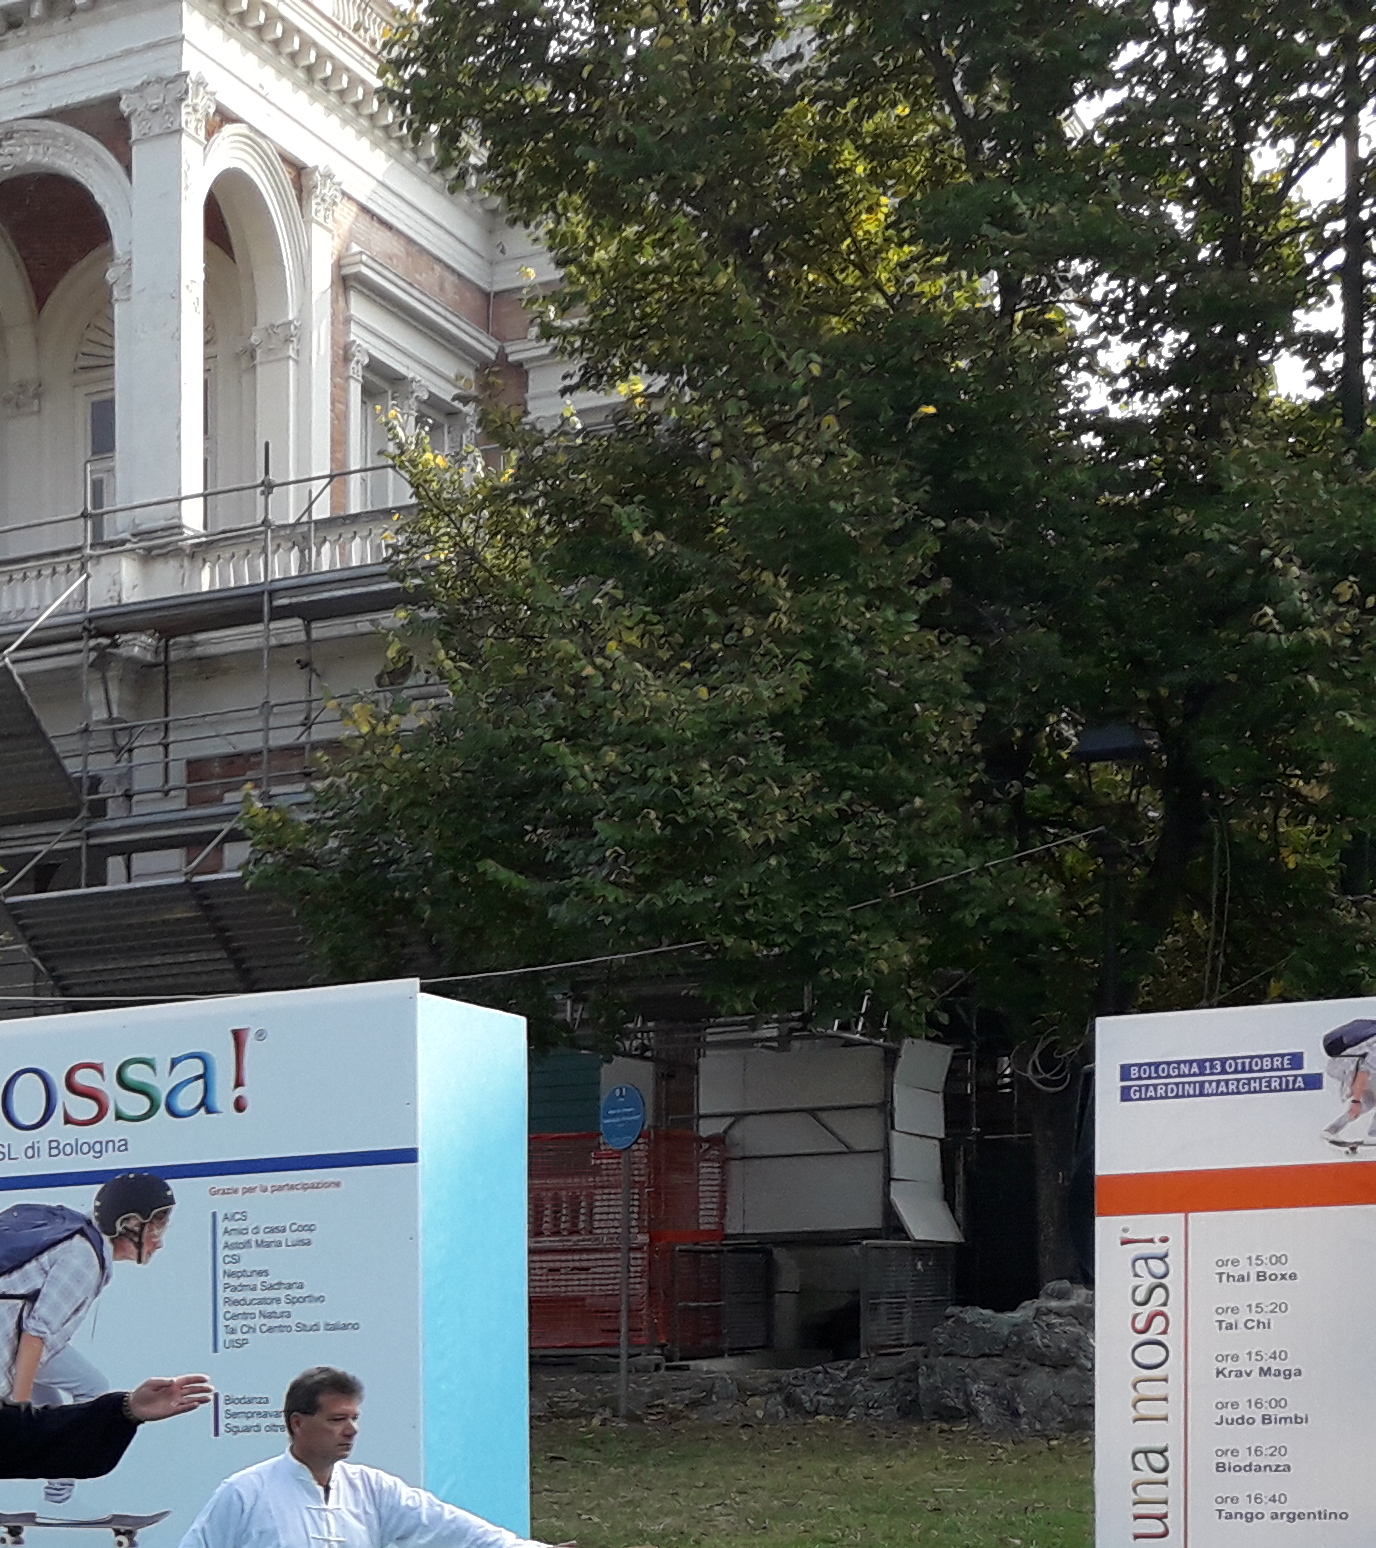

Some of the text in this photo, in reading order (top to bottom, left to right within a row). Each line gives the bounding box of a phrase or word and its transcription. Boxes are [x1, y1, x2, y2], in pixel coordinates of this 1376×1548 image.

[1130, 1055, 1293, 1080] BOLOGNA 13 OTTOBRE
[1130, 1076, 1305, 1099] GIARDINI MARGHERITA
[24, 1140, 41, 1160] di
[48, 1136, 129, 1160] Bologna
[209, 1180, 342, 1197] Grazie per la partecipazione
[222, 1211, 248, 1223] AICS
[263, 1224, 286, 1234] casa
[289, 1222, 317, 1234] Coop
[255, 1238, 283, 1248] Maria
[285, 1237, 312, 1248] Luisa
[222, 1254, 241, 1265] CSI
[1215, 1254, 1289, 1267] ore 15:00
[1215, 1270, 1298, 1283] Thai Boxe
[284, 1294, 326, 1306] Sportivo
[223, 1309, 292, 1321] Centro Natura
[1215, 1302, 1289, 1315] ore 15:20
[259, 1323, 292, 1334] Centro
[1119, 1235, 1171, 1424] mossa!
[1215, 1318, 1272, 1330] Tai Chi
[1215, 1350, 1289, 1363] ore 15:40
[1215, 1366, 1302, 1381] Krav Maga
[1214, 1398, 1288, 1410] ore 16:00
[1214, 1413, 1309, 1426] Judo Bimbi
[1214, 1445, 1288, 1458] ore 16:20
[1215, 1461, 1292, 1473] Biodanza
[1131, 1443, 1170, 1541] una
[1214, 1493, 1288, 1505] ore 16:40
[1215, 1508, 1350, 1523] Tango argentino
